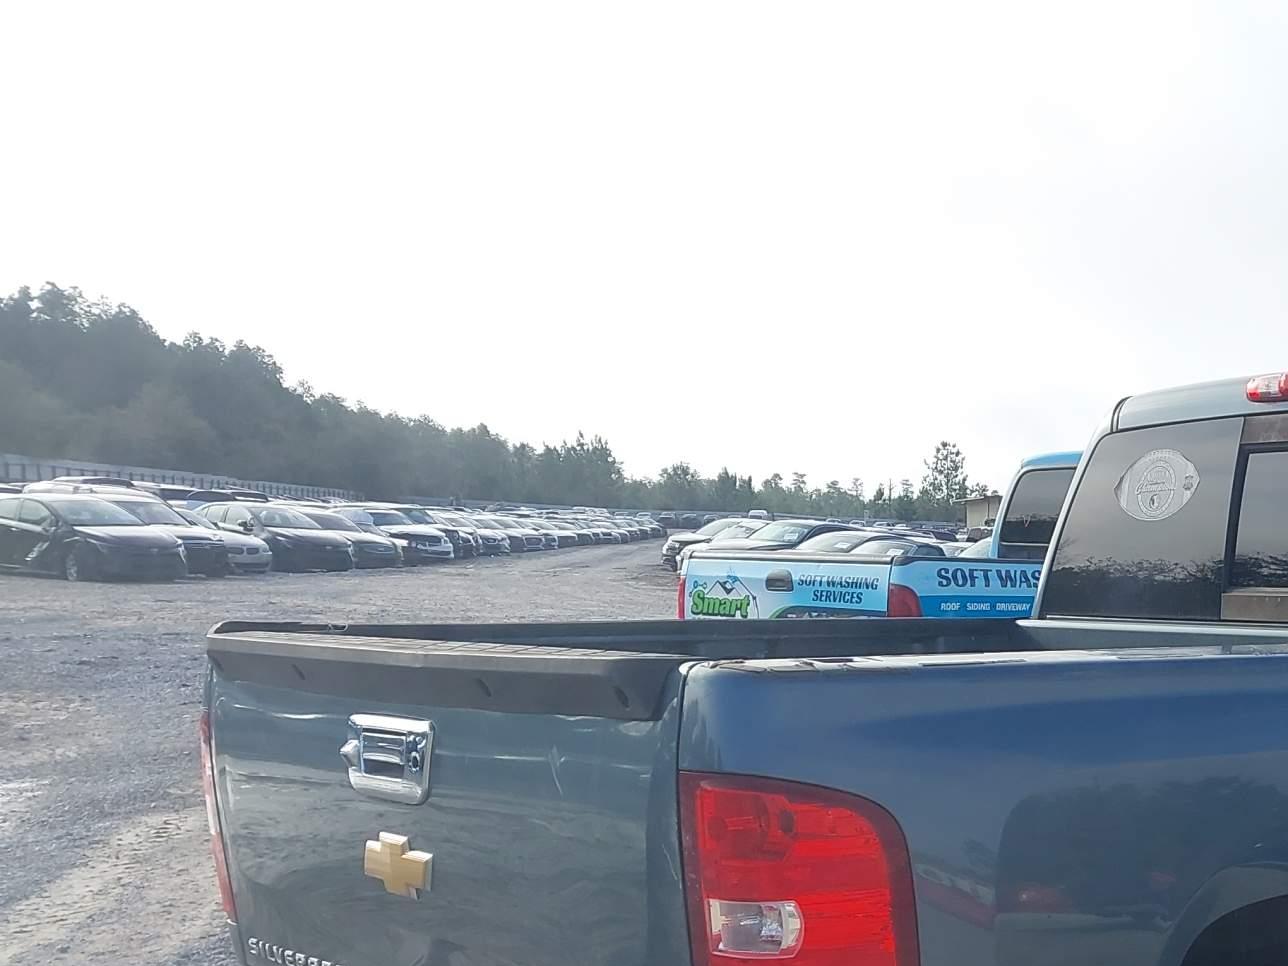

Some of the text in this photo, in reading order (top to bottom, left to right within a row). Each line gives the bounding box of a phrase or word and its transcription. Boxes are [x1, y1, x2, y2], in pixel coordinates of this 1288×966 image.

[797, 574, 880, 590] SOFT WASHING
[937, 567, 992, 588] SOFT
[691, 588, 750, 618] Smart
[812, 589, 863, 604] SERVICES
[940, 602, 1031, 611] ROOF SIDING DRIVEWAY
